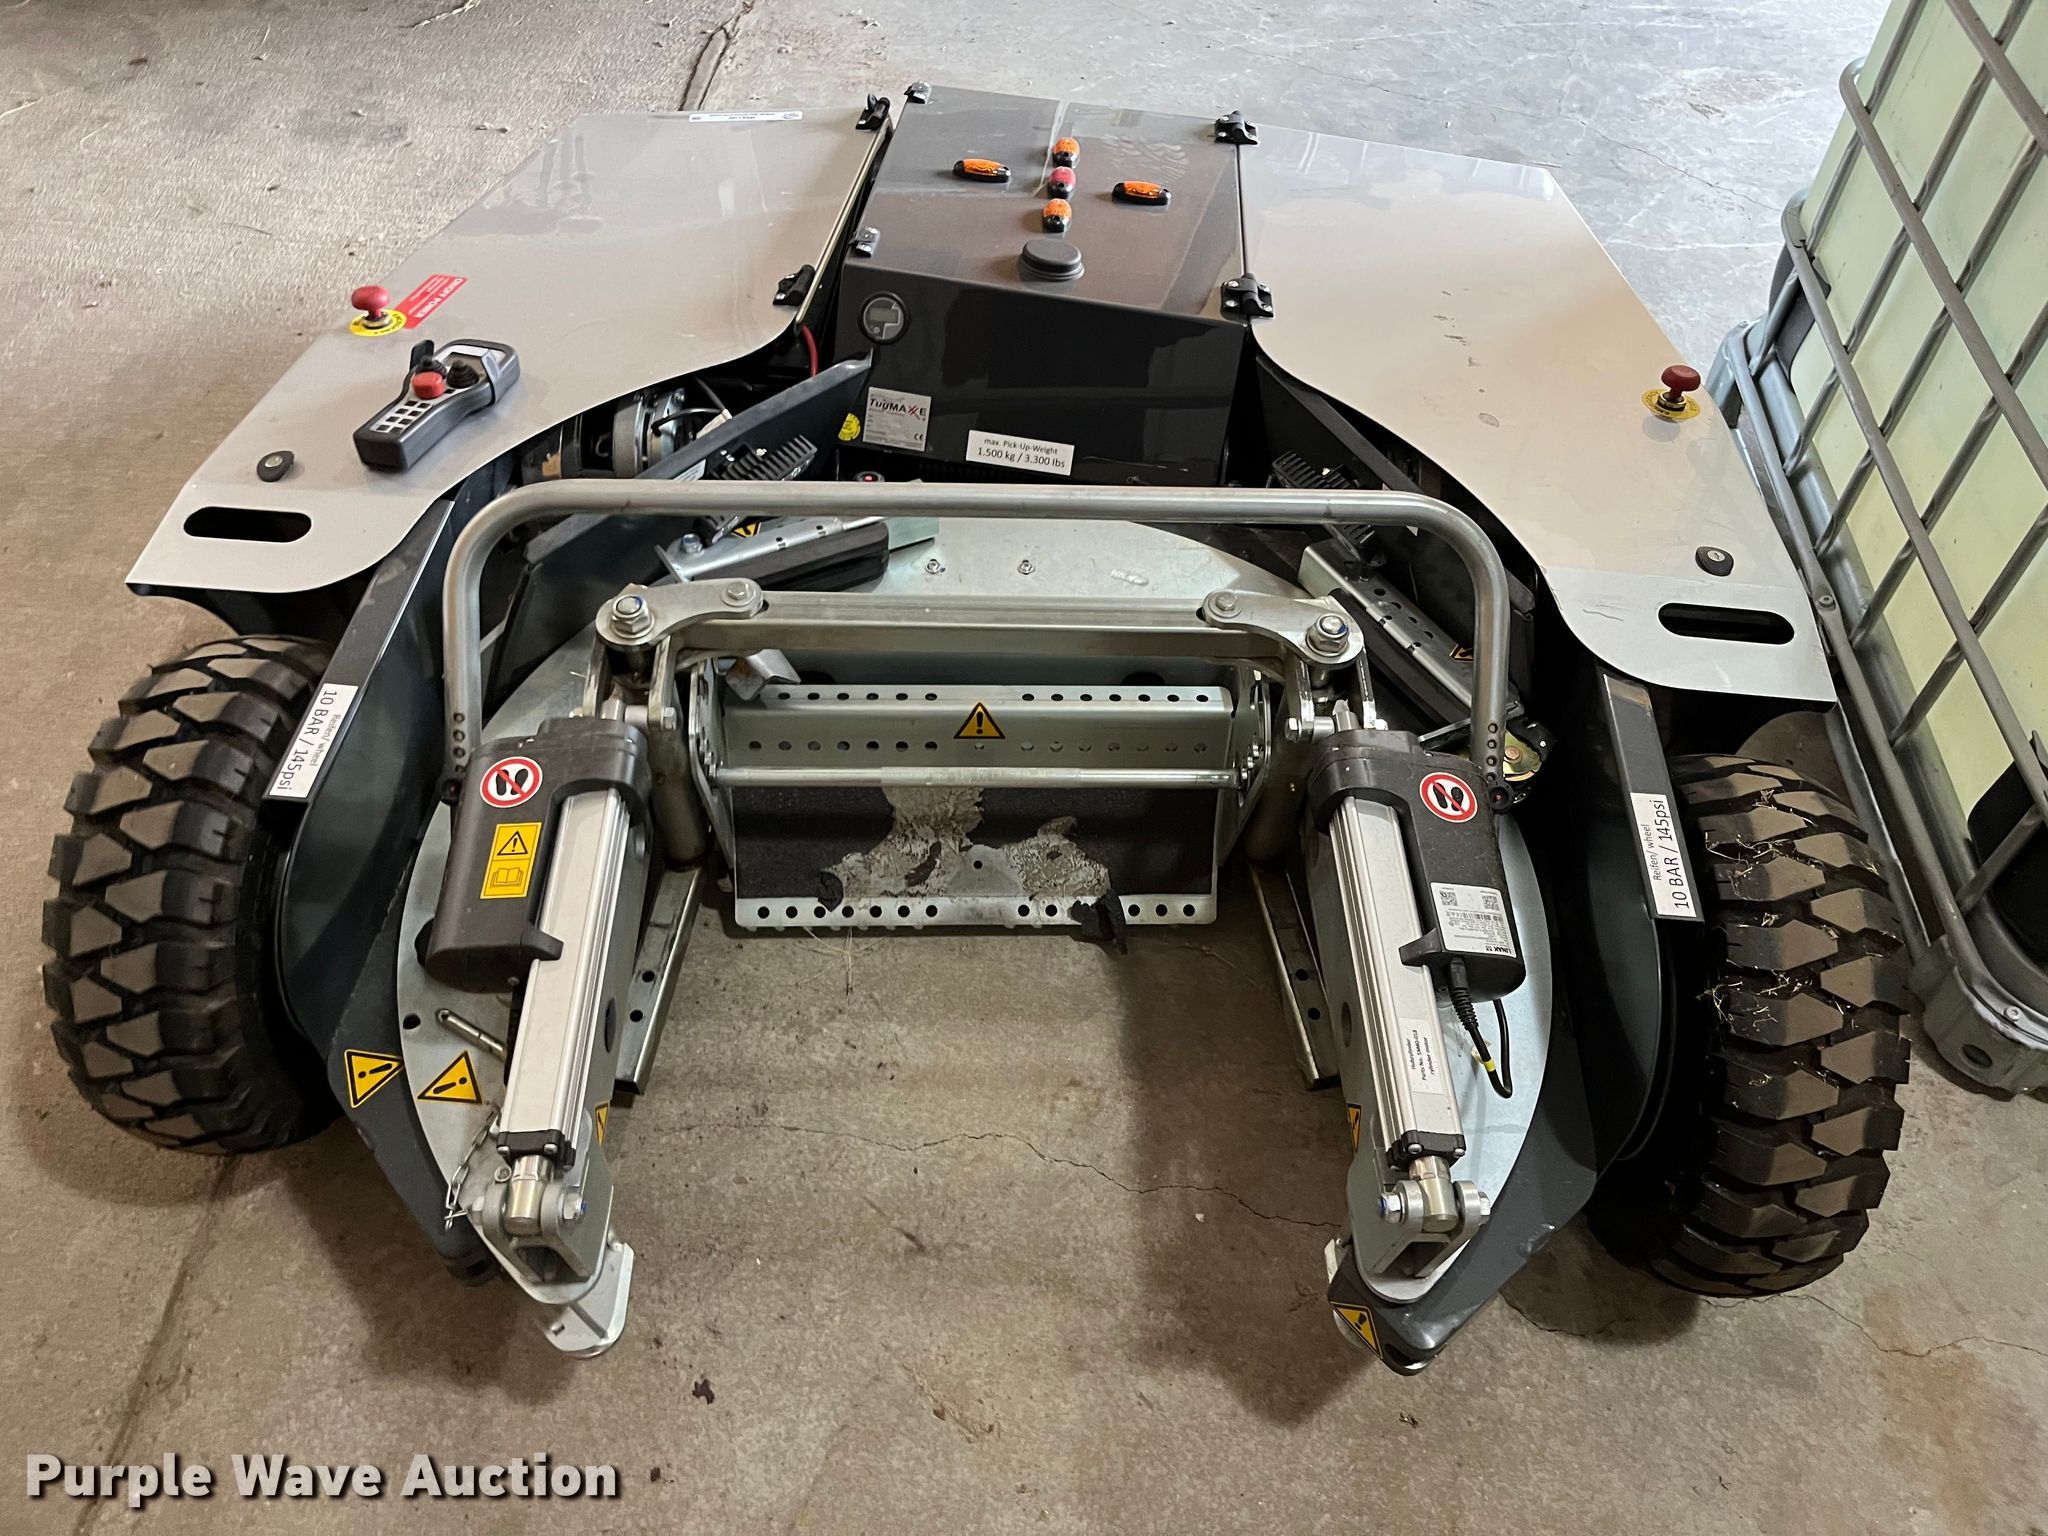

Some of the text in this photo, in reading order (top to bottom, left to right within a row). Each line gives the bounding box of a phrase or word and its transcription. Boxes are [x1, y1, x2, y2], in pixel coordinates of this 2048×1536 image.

[978, 447, 1003, 458] 1.500
[1005, 451, 1015, 462] kg
[1024, 454, 1050, 466] 3.300
[1052, 458, 1065, 468] lbs
[984, 438, 1058, 455] max. Pick-Up-Weight
[277, 690, 338, 790] 10 BAR / 145psi
[309, 743, 326, 767] wheel
[1640, 824, 1662, 881] Reifen/ wheel
[1649, 800, 1690, 909] 10 BAR / 145psi
